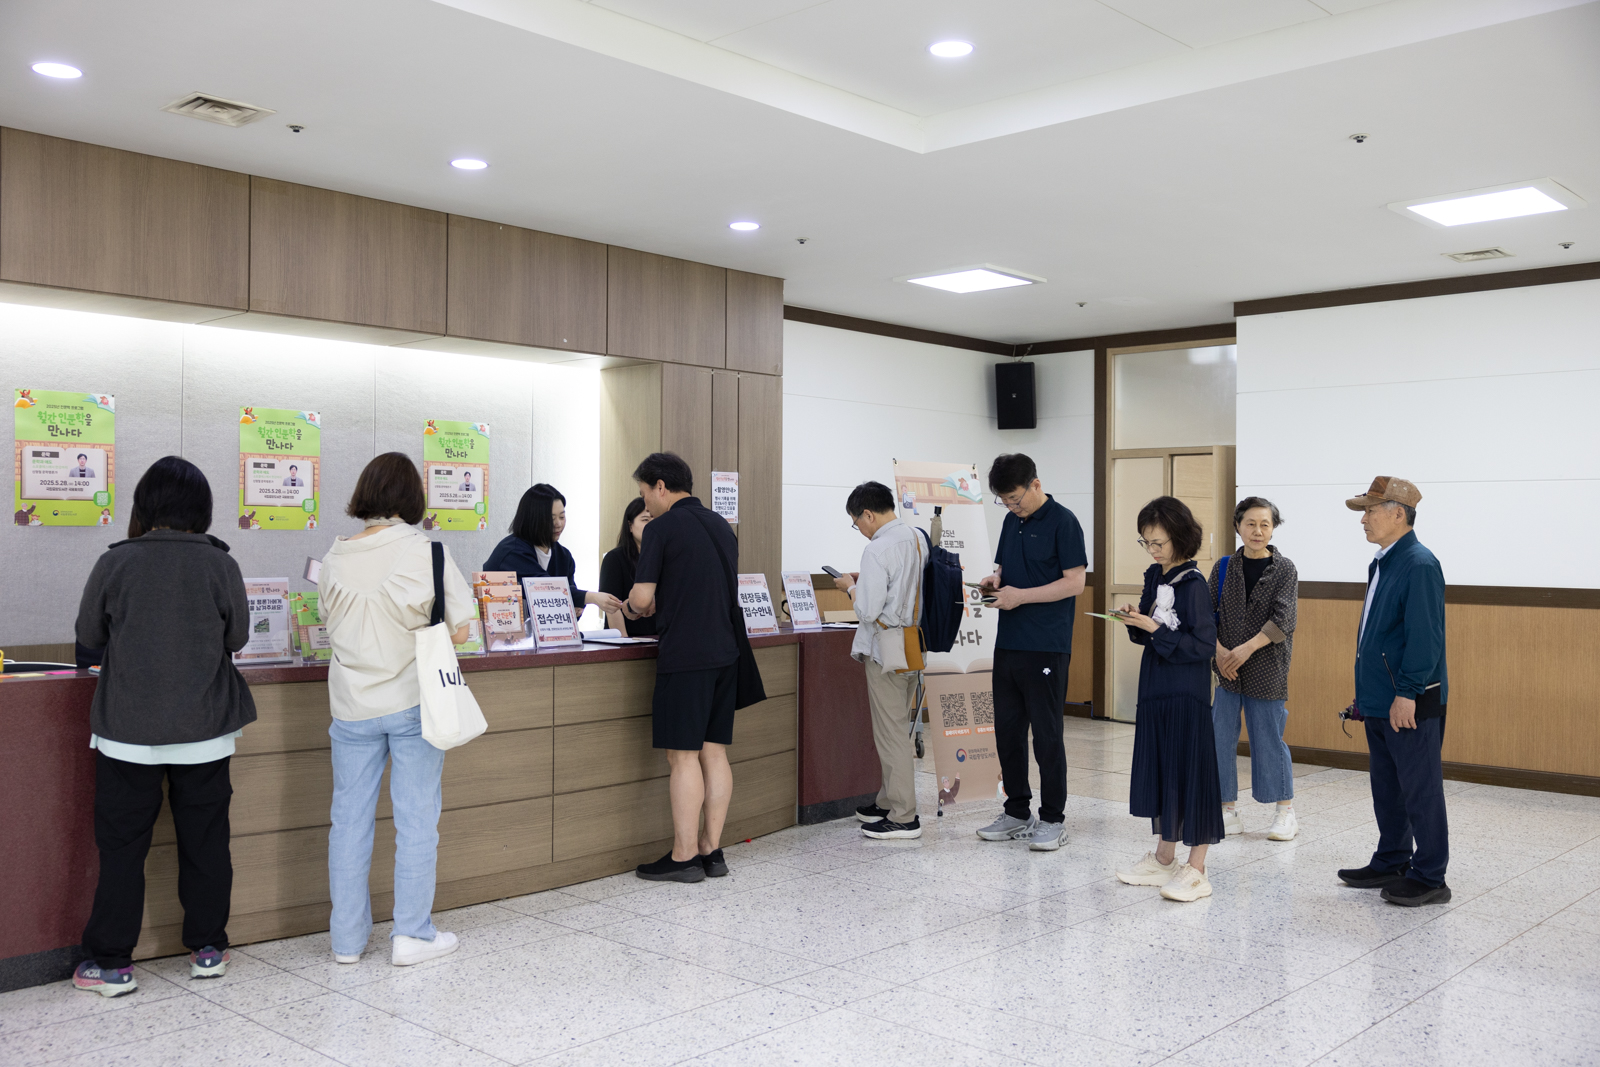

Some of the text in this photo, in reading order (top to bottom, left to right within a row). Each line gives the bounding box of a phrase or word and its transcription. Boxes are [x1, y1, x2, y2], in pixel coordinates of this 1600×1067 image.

[37, 411, 92, 426] 월간 인문학을
[48, 424, 82, 437] 만나다
[258, 426, 302, 440] 월간 인문학을
[266, 439, 294, 450] 만나다
[452, 438, 475, 449] 인문학을
[445, 448, 468, 458] 만나다
[942, 530, 955, 538] 25년
[740, 592, 769, 603] 현장등록
[789, 590, 812, 599] 직원등록
[534, 598, 568, 607] 사전신청자
[792, 602, 814, 611] 현장접수
[744, 606, 773, 617] 접수안내
[537, 613, 572, 624] 접수안내
[439, 666, 467, 687] lul
